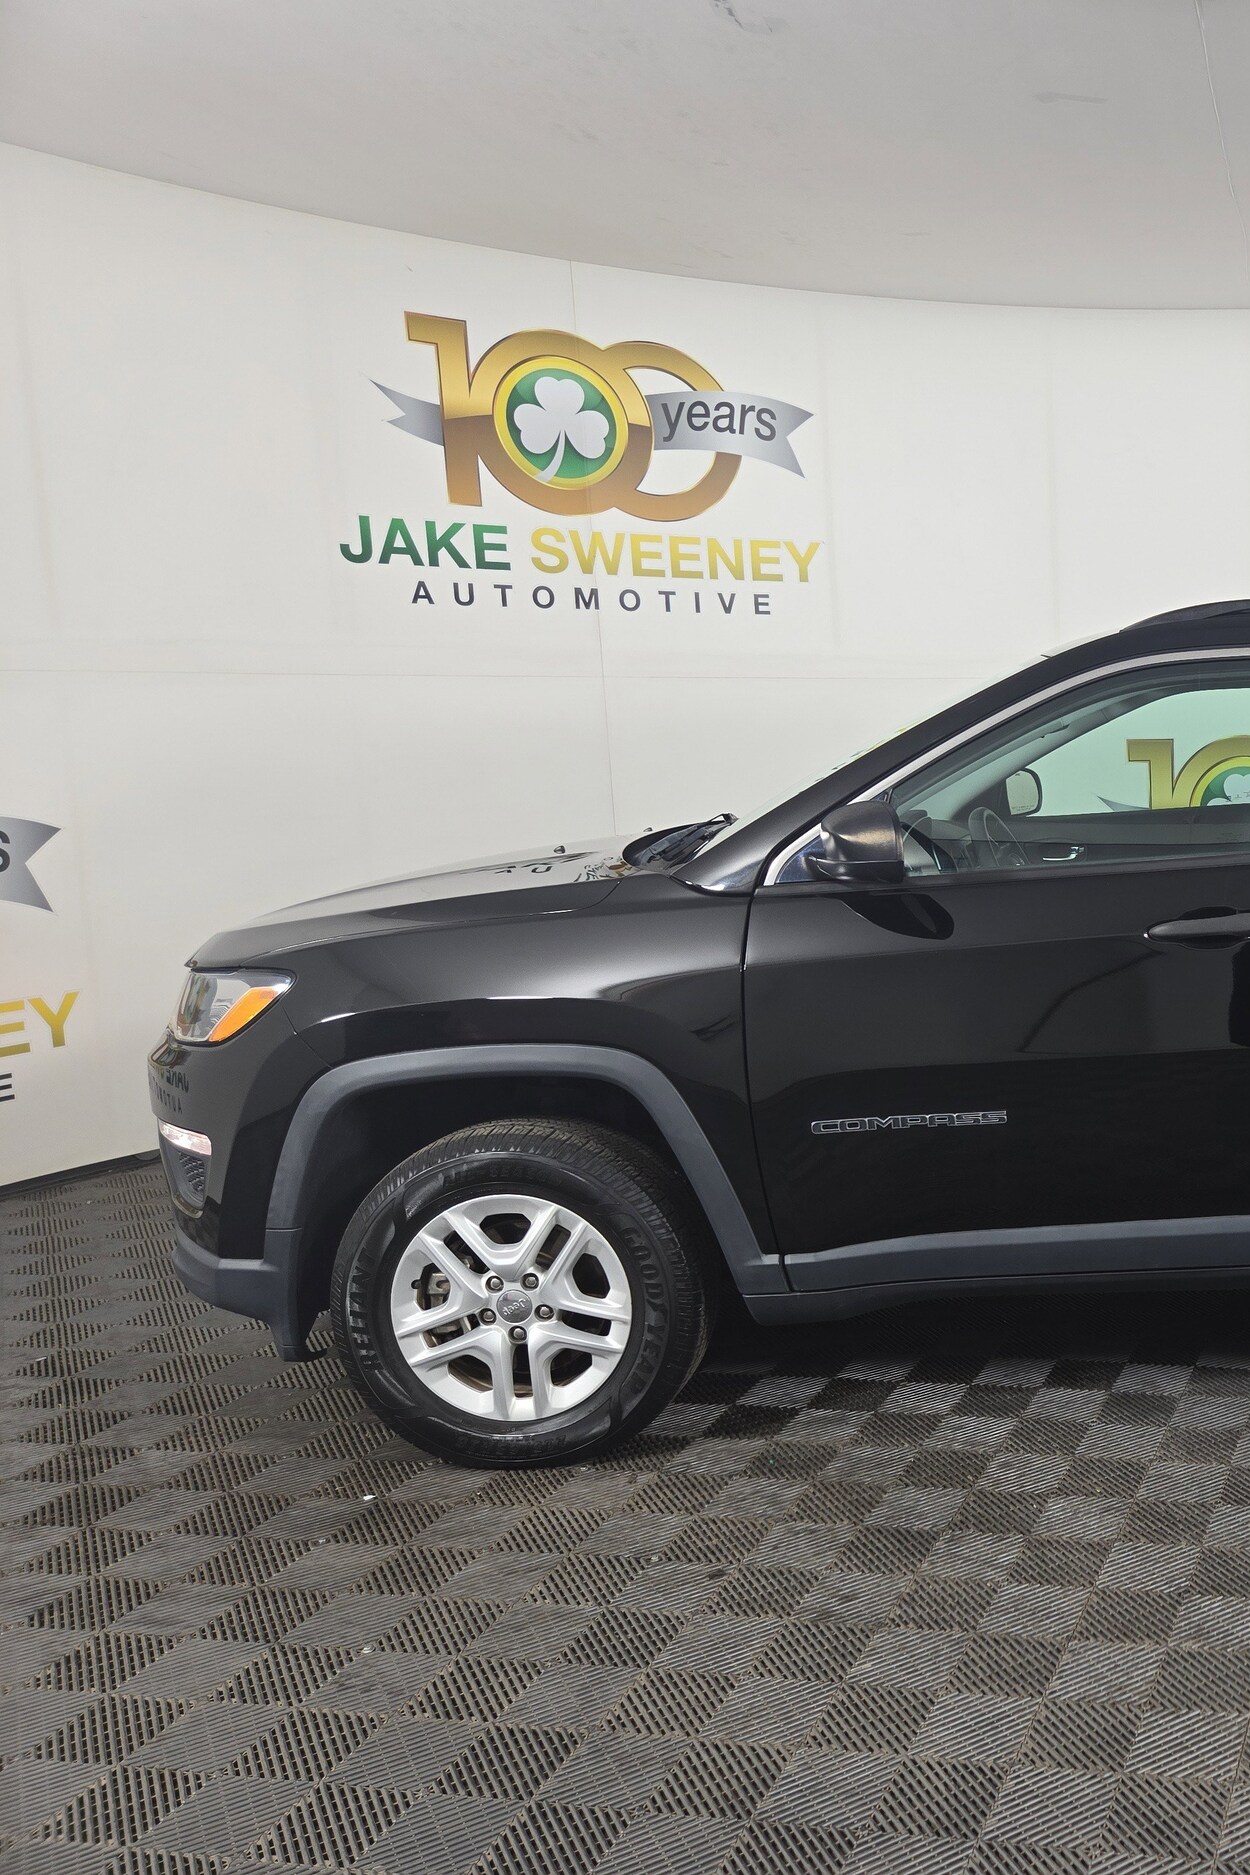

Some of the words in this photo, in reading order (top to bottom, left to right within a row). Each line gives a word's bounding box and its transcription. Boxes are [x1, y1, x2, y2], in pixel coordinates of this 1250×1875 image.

[404, 311, 742, 522] 100
[660, 398, 778, 443] years
[339, 514, 512, 571] JAKE
[529, 527, 822, 583] SWEENEY
[411, 580, 771, 615] AUTOMOTIVE
[811, 1110, 1007, 1135] COMPASS
